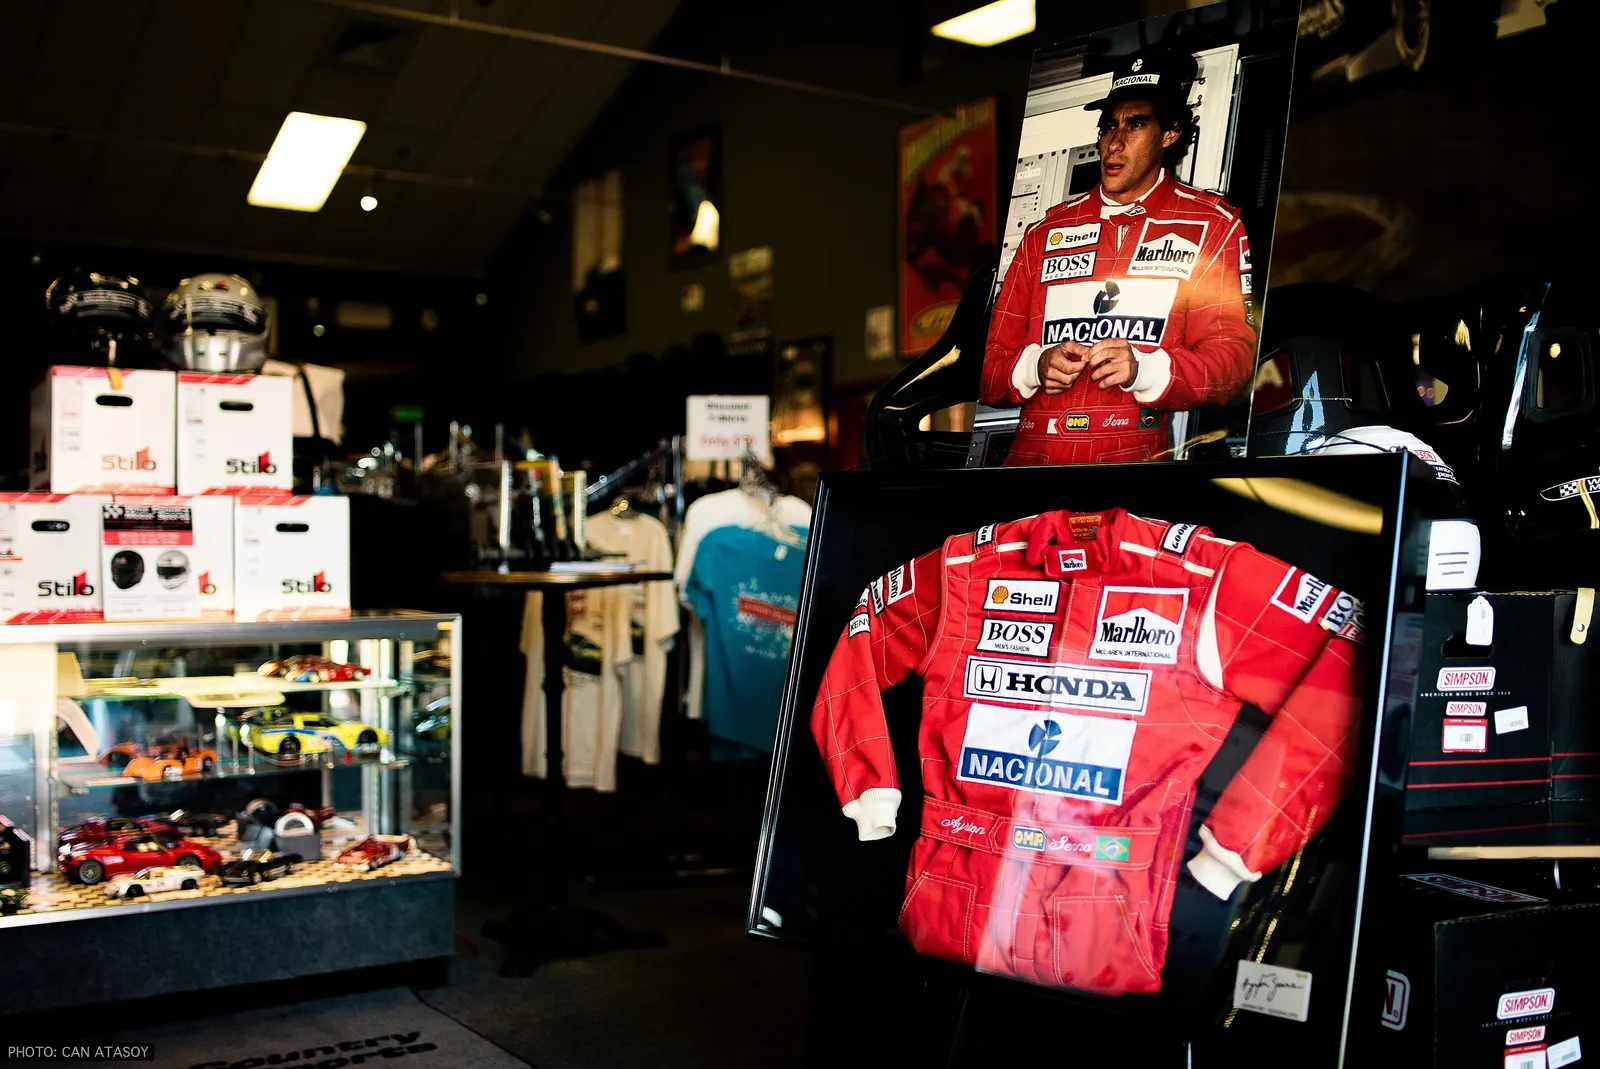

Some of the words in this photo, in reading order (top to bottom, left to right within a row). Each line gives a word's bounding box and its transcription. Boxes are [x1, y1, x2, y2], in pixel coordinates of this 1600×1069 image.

[1115, 75, 1153, 87] NACIONAL
[1064, 231, 1098, 243] Shell
[1135, 239, 1195, 264] Marlboro
[1045, 253, 1091, 275] BOSS
[1046, 318, 1160, 344] NACIONAL
[101, 447, 157, 472] Stilo
[226, 450, 277, 474] Stilo
[38, 571, 95, 597] Stilo
[282, 570, 332, 594] Stilo
[1009, 592, 1053, 607] Shell
[987, 622, 1046, 644] BOSS
[1099, 616, 1175, 646] Marlboro
[1009, 644, 1030, 652] FASHION
[1124, 650, 1171, 659] INTERNATIONAL
[1006, 672, 1136, 702] HONDA
[1444, 671, 1489, 686] SIMPSON
[1449, 703, 1483, 714] SIMPSON
[968, 753, 1110, 796] NACIONAL
[1048, 836, 1093, 853] Senna
[1504, 993, 1549, 1013] SIMPSON
[1509, 1028, 1542, 1043] SIMPSON
